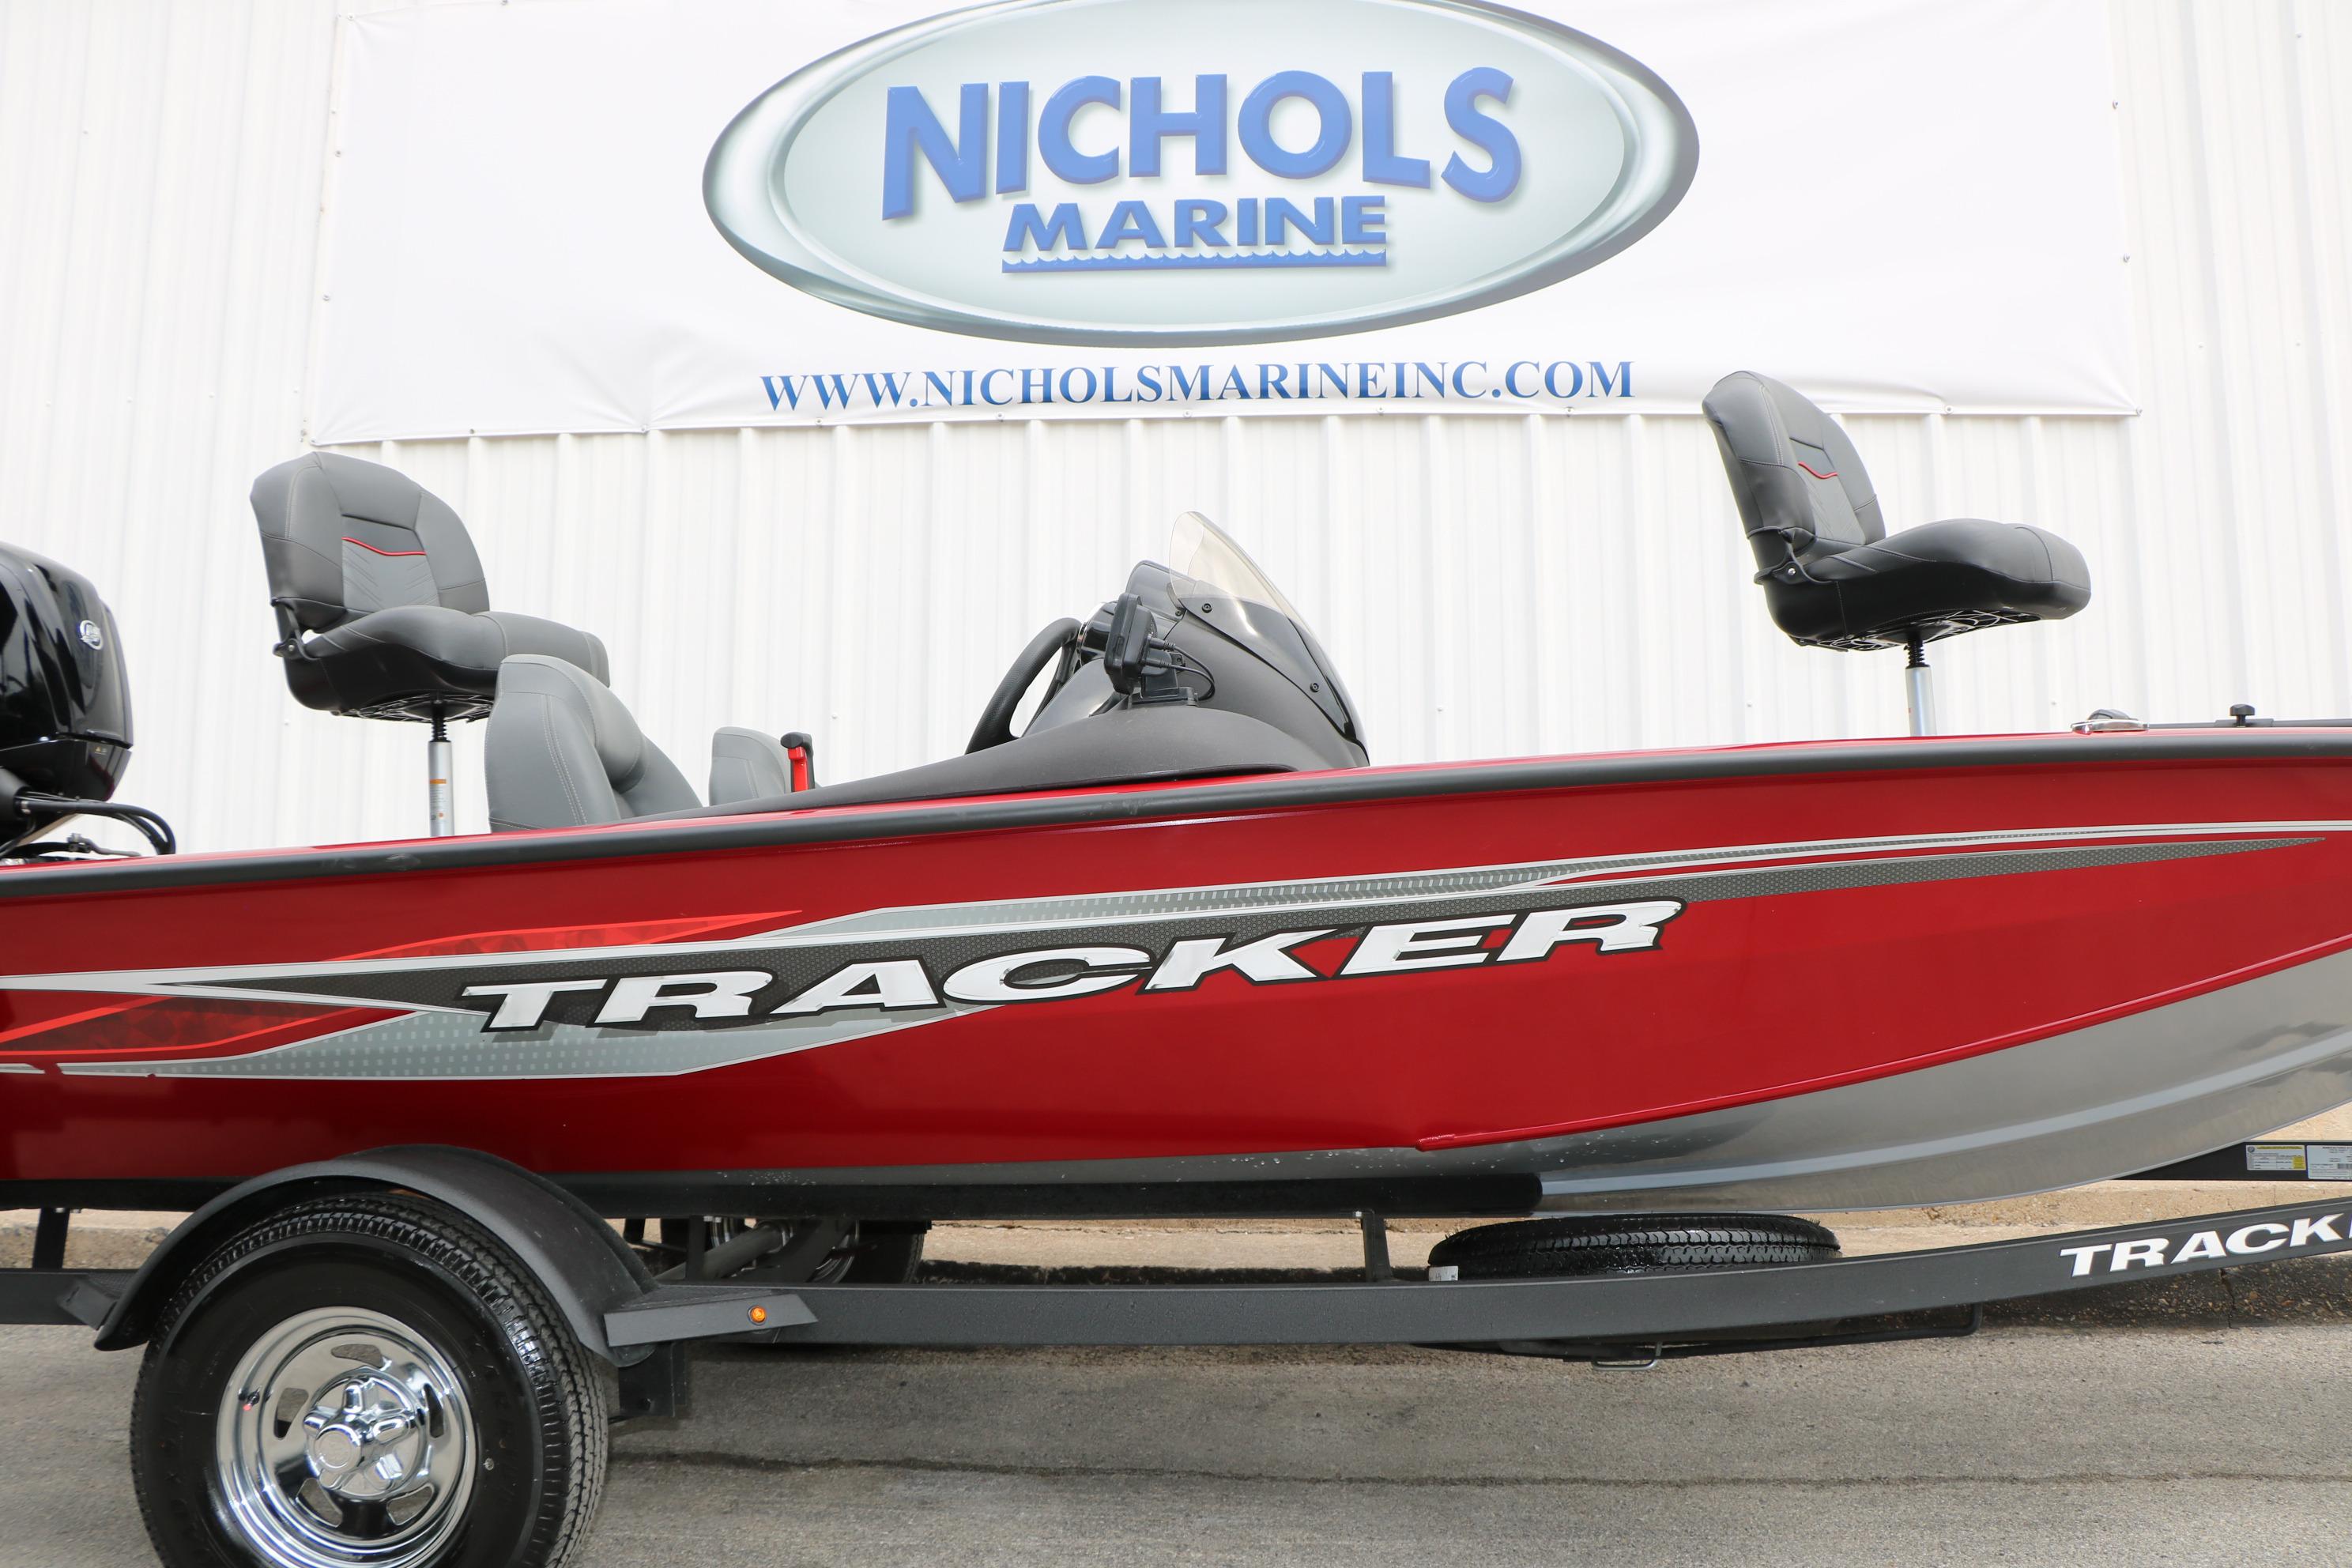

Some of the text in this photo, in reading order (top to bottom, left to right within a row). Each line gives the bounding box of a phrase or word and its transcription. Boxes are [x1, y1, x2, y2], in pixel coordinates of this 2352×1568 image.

[883, 67, 1522, 221] NICHOLS
[1002, 195, 1386, 252] MARINE
[760, 360, 1634, 412] WWW.NICHOLSMARINEINC.COM
[458, 898, 1685, 1031] TRACKER
[2060, 1212, 2352, 1277] TRACK
